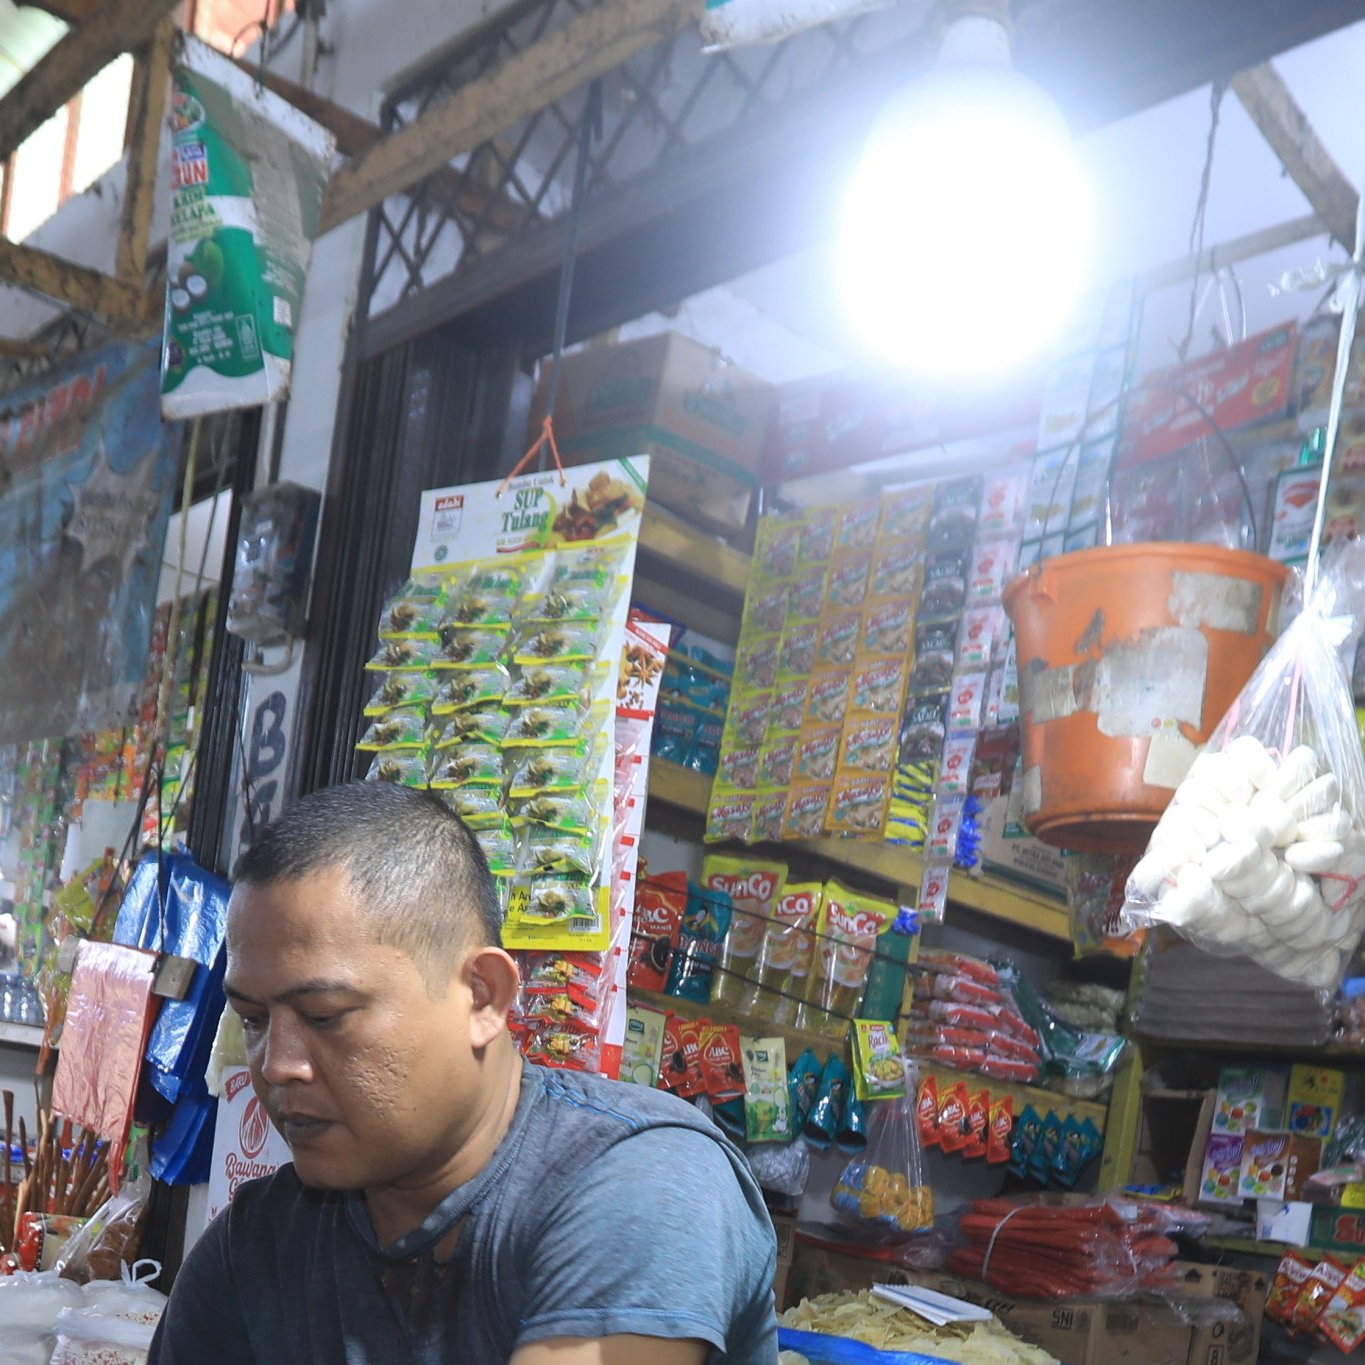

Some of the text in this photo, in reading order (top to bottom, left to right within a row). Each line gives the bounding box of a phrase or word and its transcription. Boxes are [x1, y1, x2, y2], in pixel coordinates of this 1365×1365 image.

[513, 486, 544, 511] SUP
[501, 507, 549, 533] Tulang
[711, 872, 772, 900] SunCo
[829, 902, 877, 935] SunCo
[707, 1044, 729, 1058] ABC
[867, 1033, 890, 1049] Racik
[225, 1152, 278, 1181] Bawang
[1052, 1309, 1074, 1329] SNI
